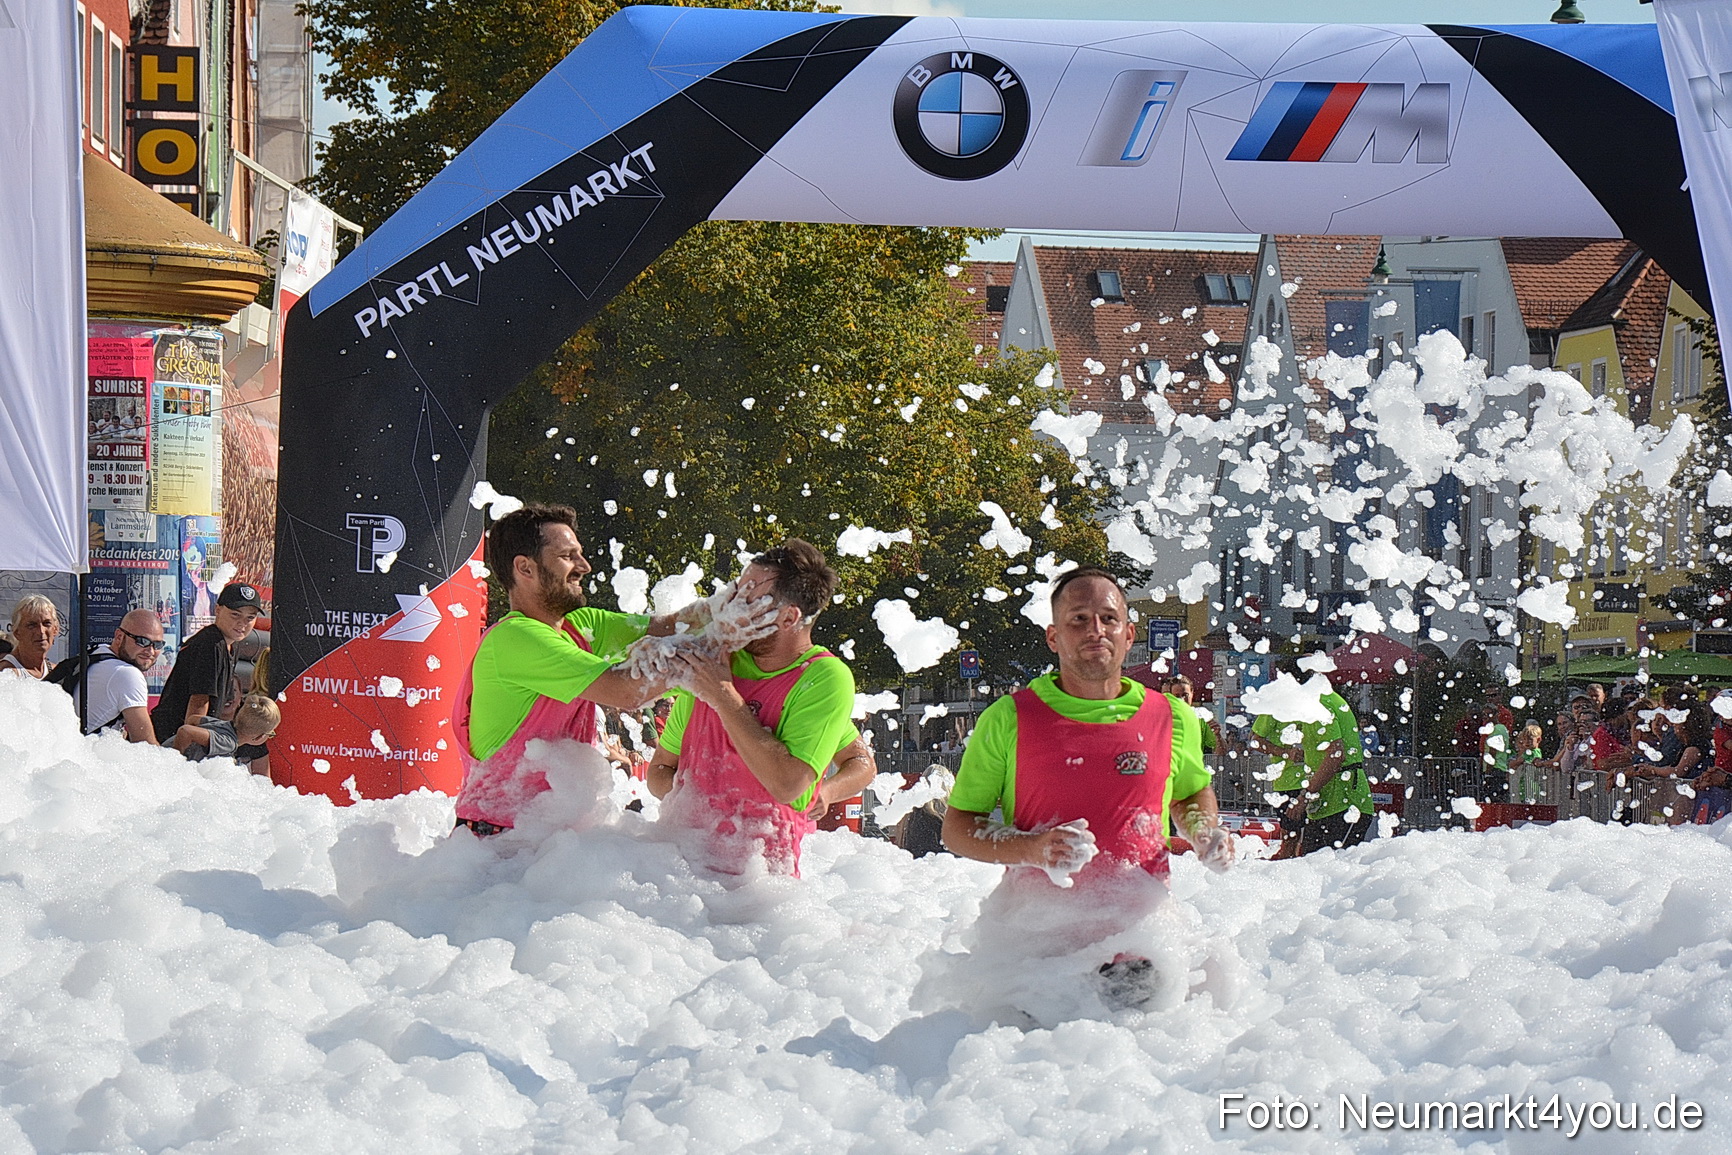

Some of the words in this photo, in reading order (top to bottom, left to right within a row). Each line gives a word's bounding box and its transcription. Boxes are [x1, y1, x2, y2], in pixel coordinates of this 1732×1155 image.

[907, 52, 1019, 91] BMW
[137, 55, 197, 214] HO
[353, 261, 470, 338] PARTL
[466, 141, 658, 272] NEUMARKT
[94, 379, 144, 394] SUNRISE
[151, 399, 160, 442] Sukkulenten
[163, 433, 184, 441] Kakteen
[96, 444, 110, 457] 20
[112, 444, 144, 457] JAHRE
[151, 443, 159, 467] andere
[109, 463, 114, 471] &
[115, 462, 144, 472] Konzert
[103, 473, 127, 485] 18.30
[128, 474, 144, 485] Uhr
[151, 469, 159, 482] und
[108, 486, 144, 496] Neumarkt
[350, 517, 369, 525] Team
[158, 548, 181, 561] 2019
[93, 578, 115, 586] Freitag
[94, 586, 123, 594] Oktober
[92, 594, 102, 602] 20
[1596, 600, 1637, 609] TAIFN
[324, 610, 350, 625] THE
[352, 612, 389, 627] NEXT
[304, 623, 325, 637] 100
[326, 624, 371, 639] YEARS
[90, 635, 115, 644] Samsta
[302, 676, 349, 695] BMW
[353, 680, 442, 704] Lasport
[301, 743, 439, 763] www.bmw-partl.de
